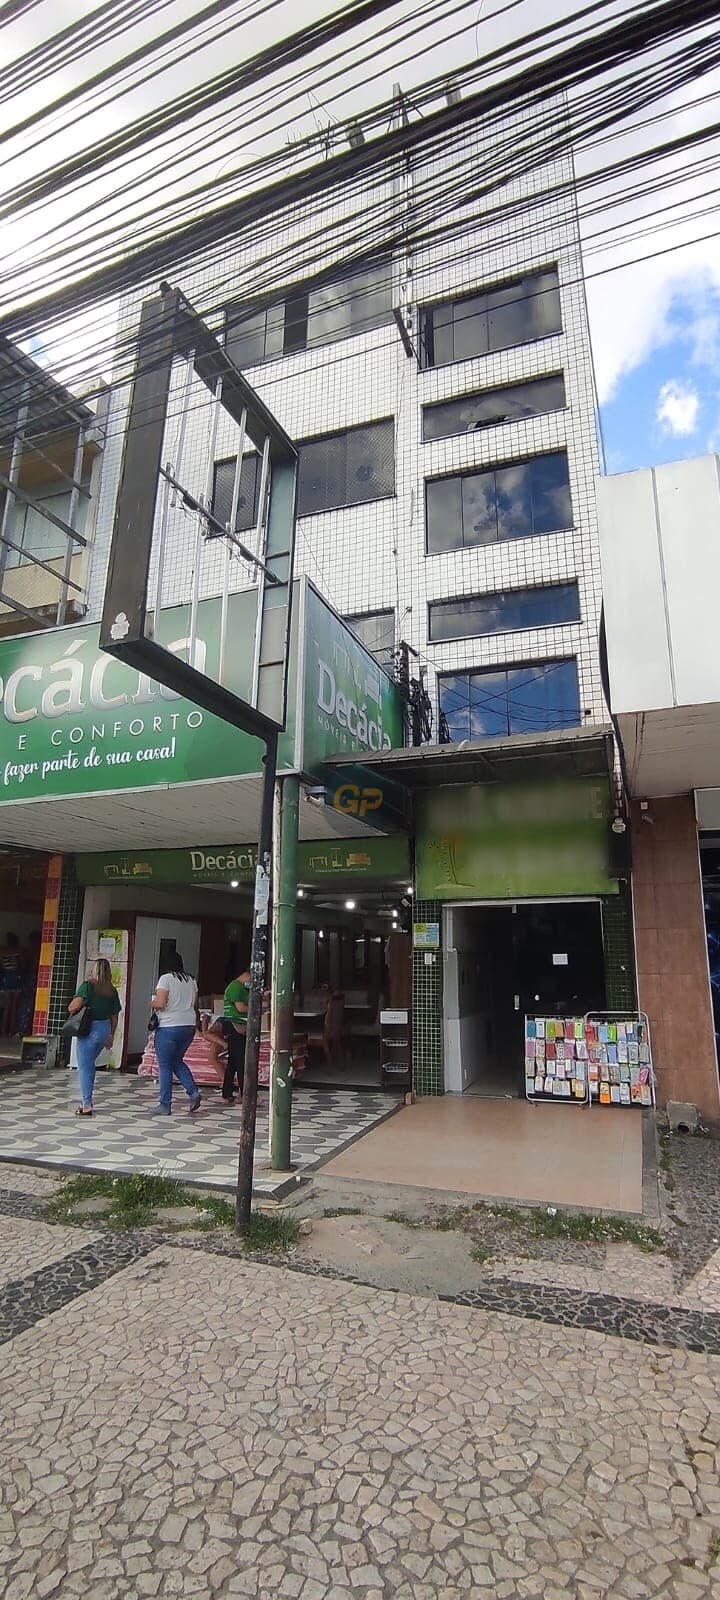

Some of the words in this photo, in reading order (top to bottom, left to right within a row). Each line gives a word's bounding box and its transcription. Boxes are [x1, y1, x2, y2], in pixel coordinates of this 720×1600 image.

[18, 734, 28, 751] E
[51, 711, 203, 746] CONFORTO
[4, 761, 39, 786] fazer
[42, 750, 81, 779] parte
[84, 746, 102, 768] de
[106, 752, 133, 765] sua
[136, 736, 176, 760] casa!
